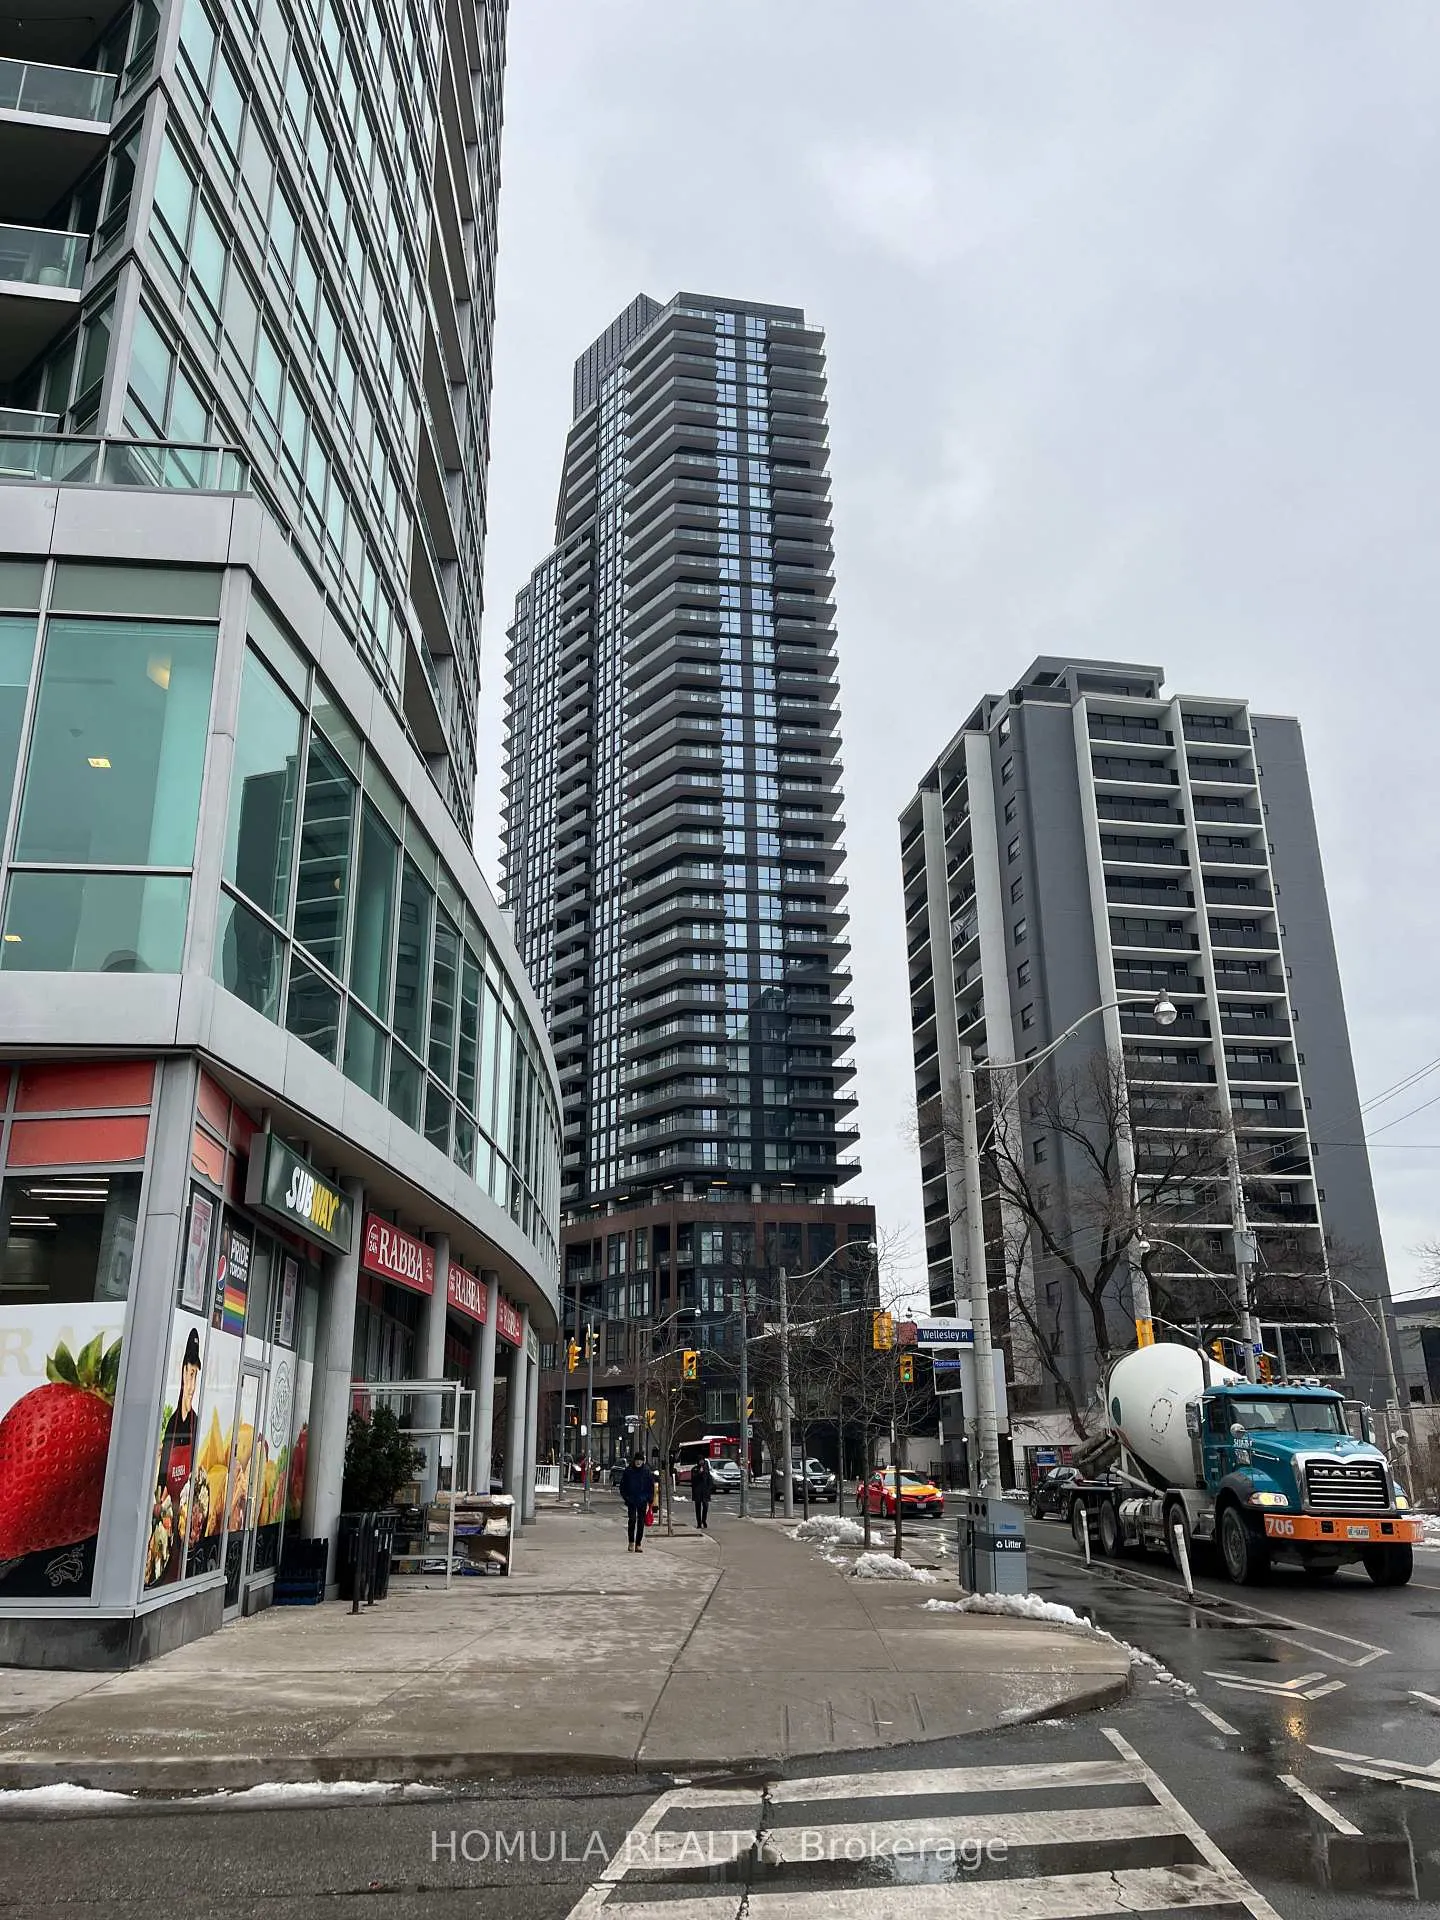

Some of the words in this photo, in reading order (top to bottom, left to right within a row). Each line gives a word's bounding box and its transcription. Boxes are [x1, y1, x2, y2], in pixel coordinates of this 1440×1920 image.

[285, 1166, 340, 1233] SUBWAY
[230, 1237, 250, 1268] PRIDE
[378, 1227, 424, 1284] RABBA
[229, 1261, 248, 1283] TORONTO
[455, 1269, 481, 1316] RABBA
[922, 1329, 960, 1341] Wellesley
[961, 1331, 968, 1339] Pl
[1313, 1469, 1377, 1478] MACK
[1265, 1517, 1295, 1536] 706
[1004, 1539, 1022, 1549] Litter
